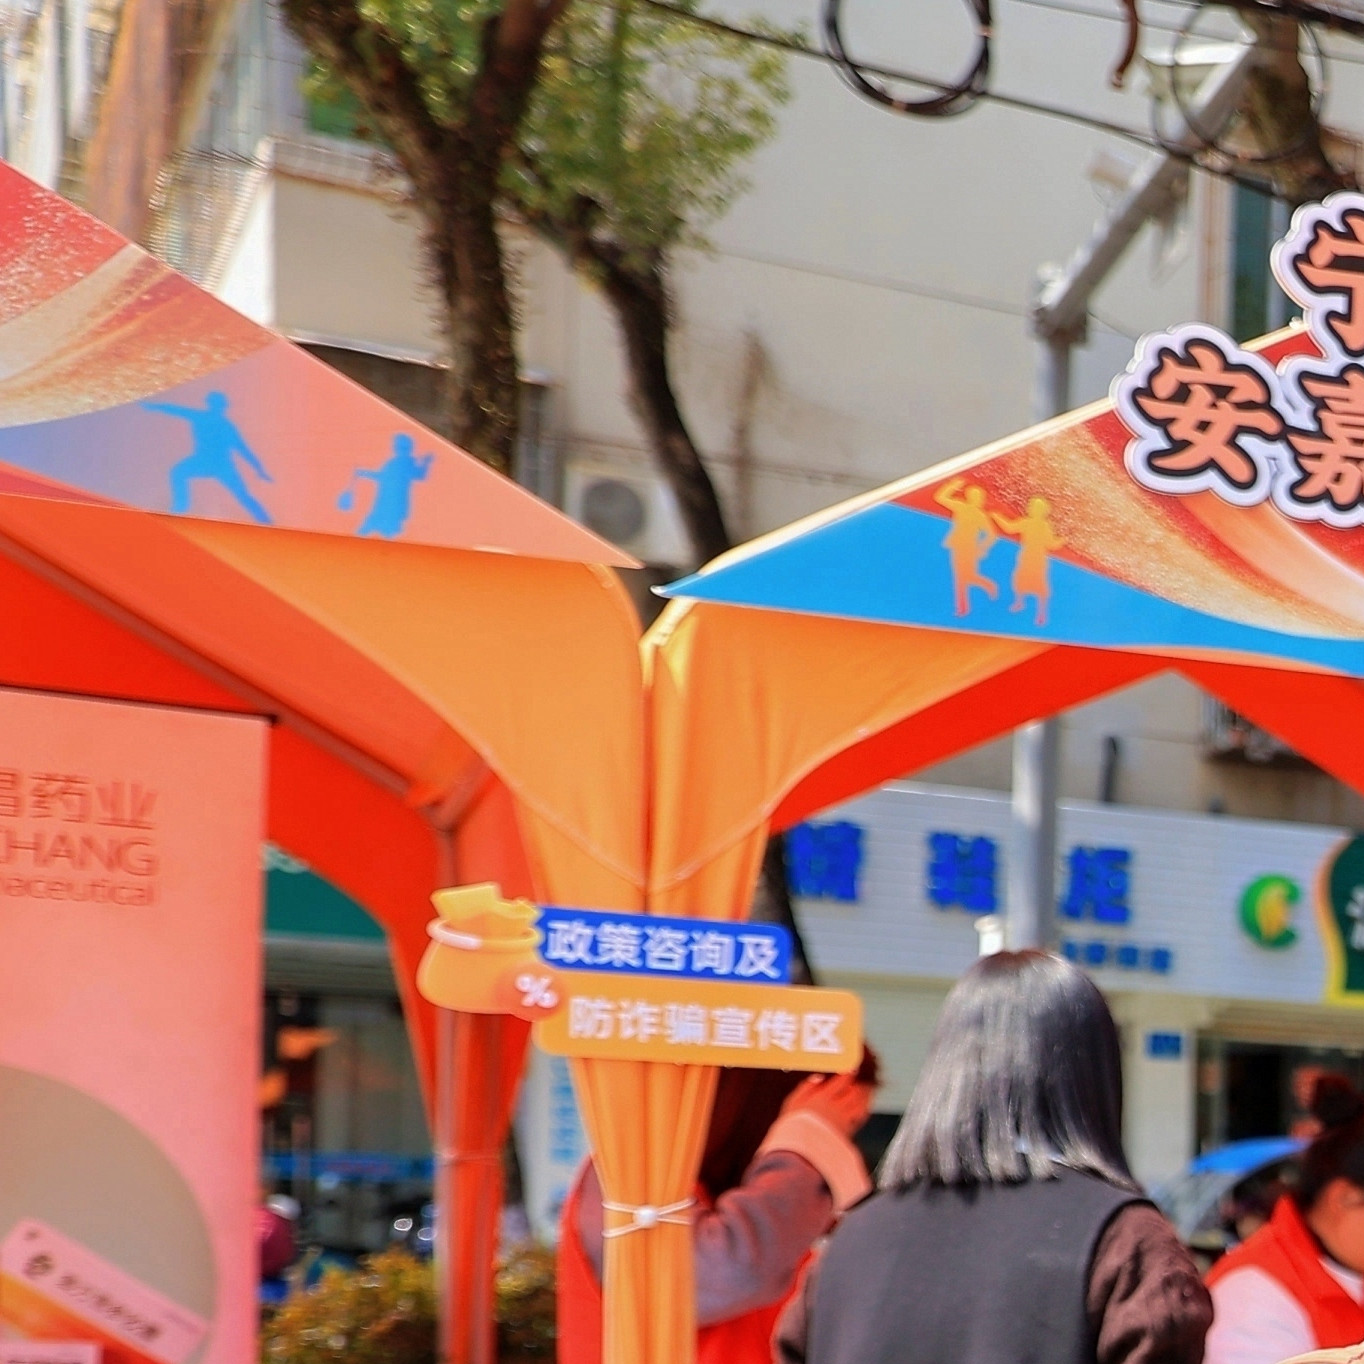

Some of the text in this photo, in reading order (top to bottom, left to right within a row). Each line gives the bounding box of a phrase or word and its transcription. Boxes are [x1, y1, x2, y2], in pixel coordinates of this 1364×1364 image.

[0, 826, 159, 877] HANG
[545, 918, 782, 980] 政策咨询及
[567, 996, 845, 1055] 防诈骗宣传区
